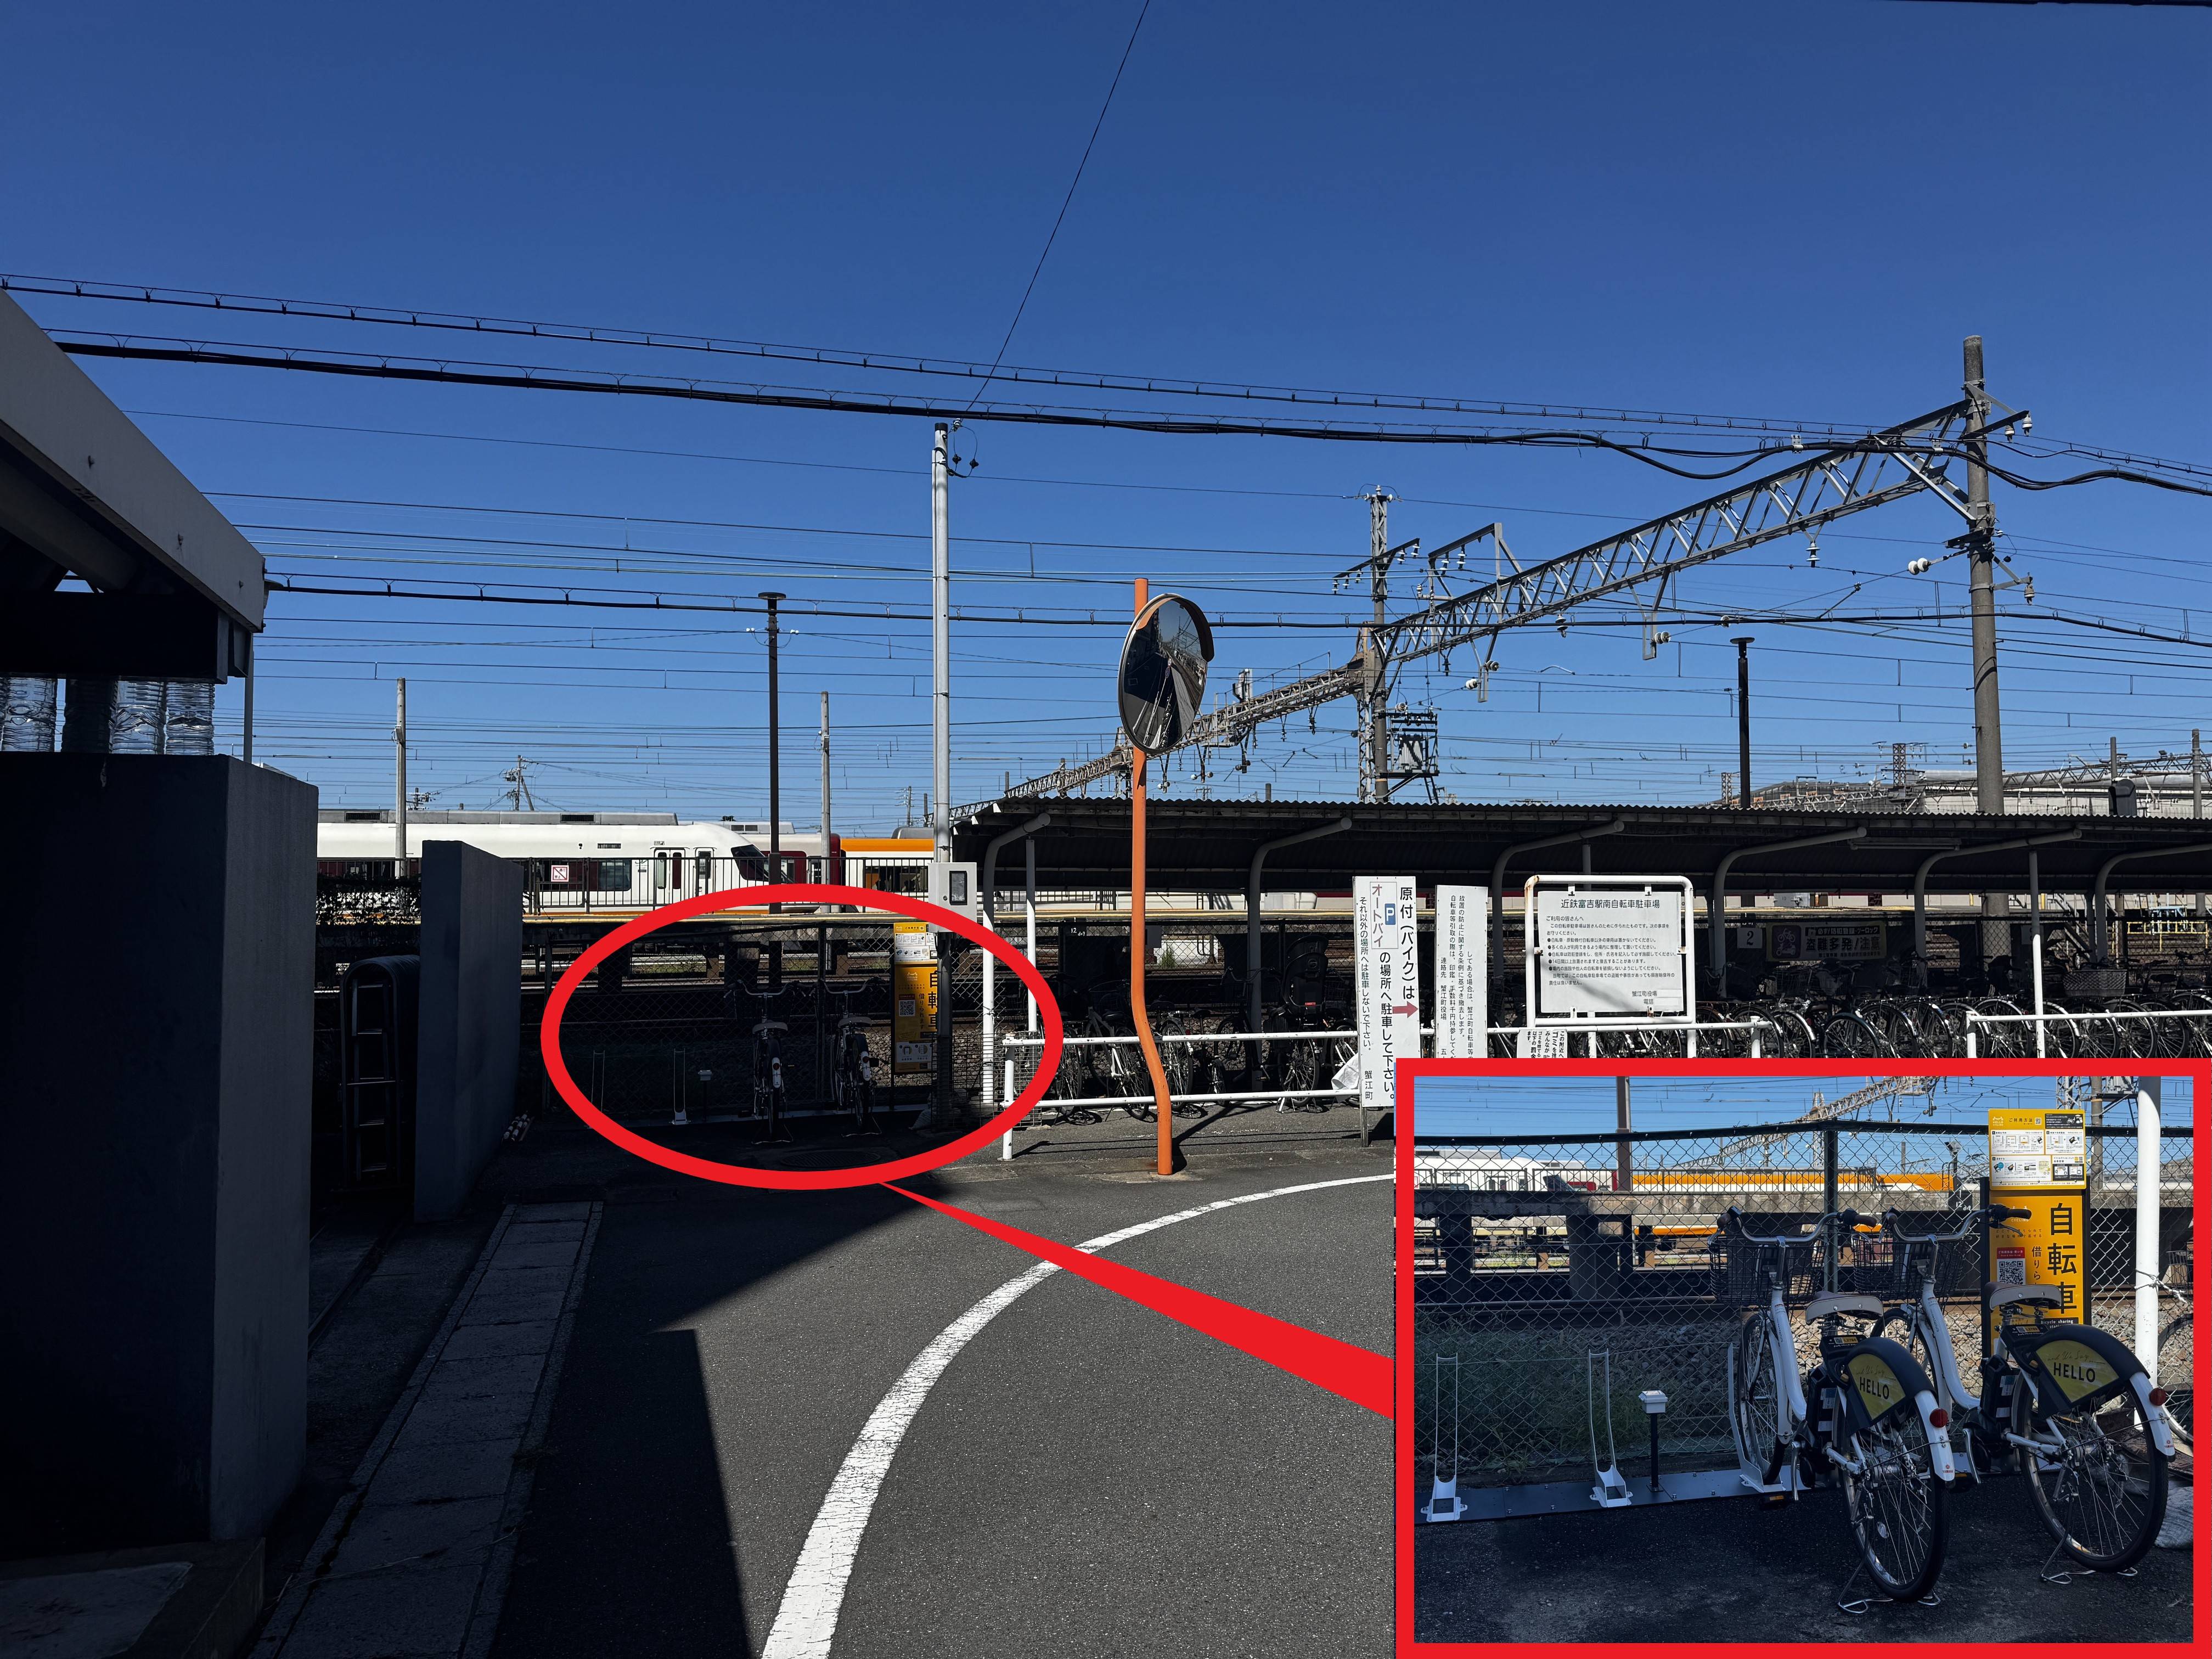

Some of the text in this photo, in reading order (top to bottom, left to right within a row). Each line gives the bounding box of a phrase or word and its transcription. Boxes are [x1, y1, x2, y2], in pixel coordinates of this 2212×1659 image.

[1372, 884, 1383, 947] オートバイ
[1386, 907, 1394, 921] P
[1561, 899, 1660, 908] 近鉄富吉駅南自転車駐車場
[1747, 930, 1754, 946] 2
[1359, 897, 1371, 1050] それ以外の場所へは駐車しないで下さい。
[1380, 952, 1394, 1099] の場所へ駐車して下さい。
[1365, 1071, 1373, 1100] 蟹江町
[2032, 1246, 2042, 1285] 借りら
[2047, 1202, 2077, 1314] 自転車
[2053, 1362, 2095, 1382] HELLO
[1859, 1376, 1889, 1399] HELLO
